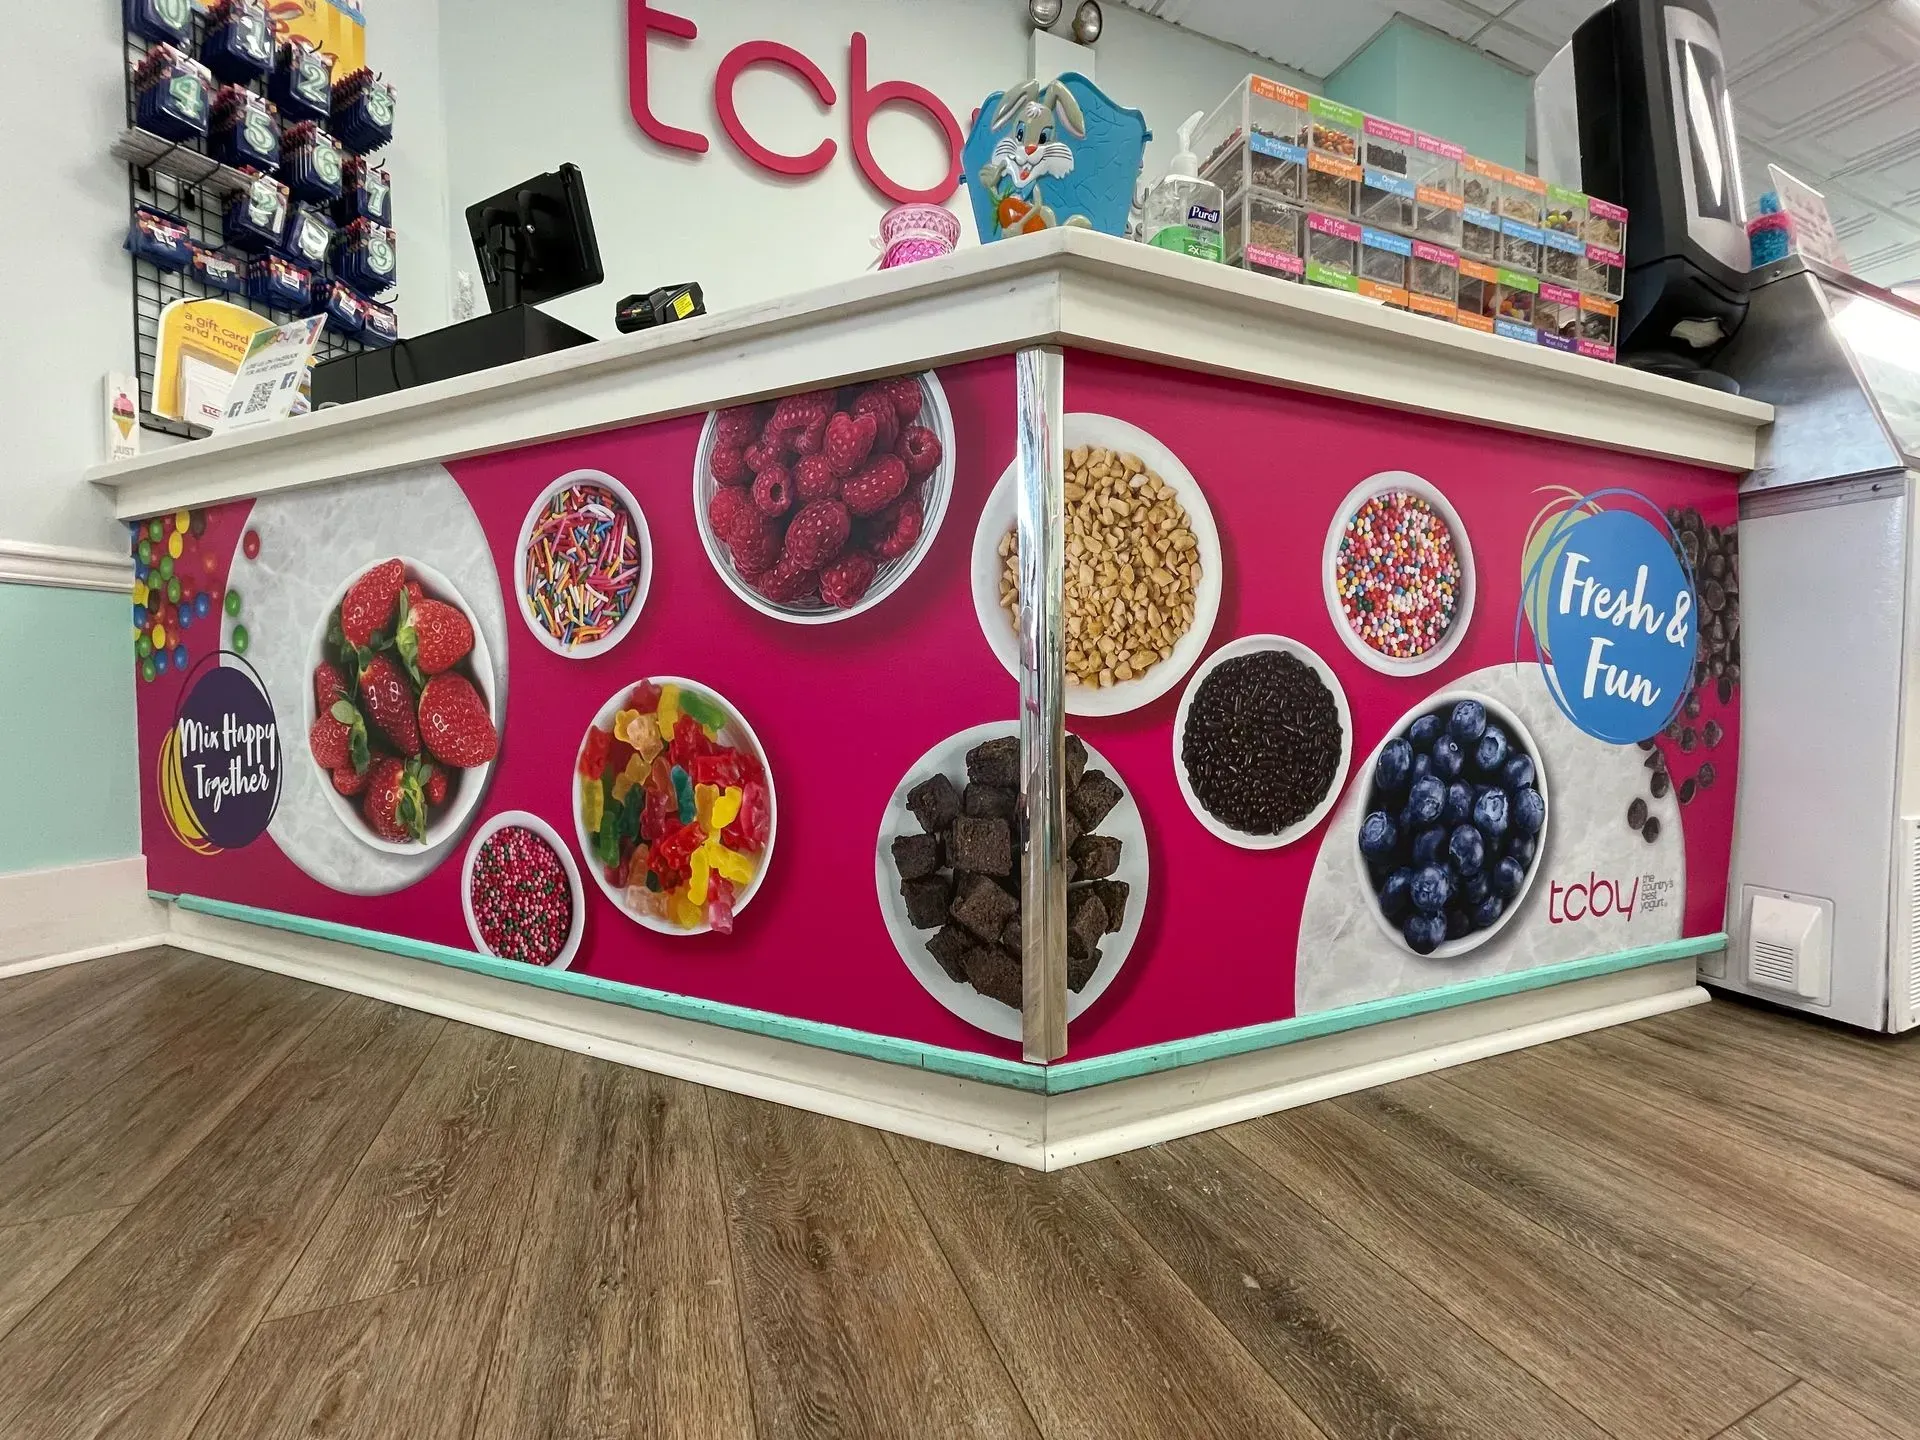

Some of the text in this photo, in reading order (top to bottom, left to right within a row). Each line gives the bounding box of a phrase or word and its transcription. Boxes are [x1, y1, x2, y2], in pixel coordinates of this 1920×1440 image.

[297, 62, 329, 104] 2
[627, 0, 980, 205] tcb
[244, 104, 277, 154] 5
[312, 145, 341, 184] 6
[1192, 206, 1218, 222] Purell
[1323, 217, 1344, 231] Kit Kat
[1329, 225, 1338, 236] 1/2
[368, 238, 395, 275] 9
[1247, 245, 1274, 259] chocolate
[183, 323, 209, 339] and
[212, 335, 246, 354] more
[184, 312, 193, 320] a
[196, 316, 219, 331] gift
[221, 328, 249, 346] card
[113, 445, 135, 456] JUST
[1559, 551, 1691, 648] Fresh &
[1583, 636, 1661, 707] Fun
[178, 712, 276, 771] Mix Happy
[193, 755, 270, 813] Together
[1549, 871, 1639, 924] tcby
